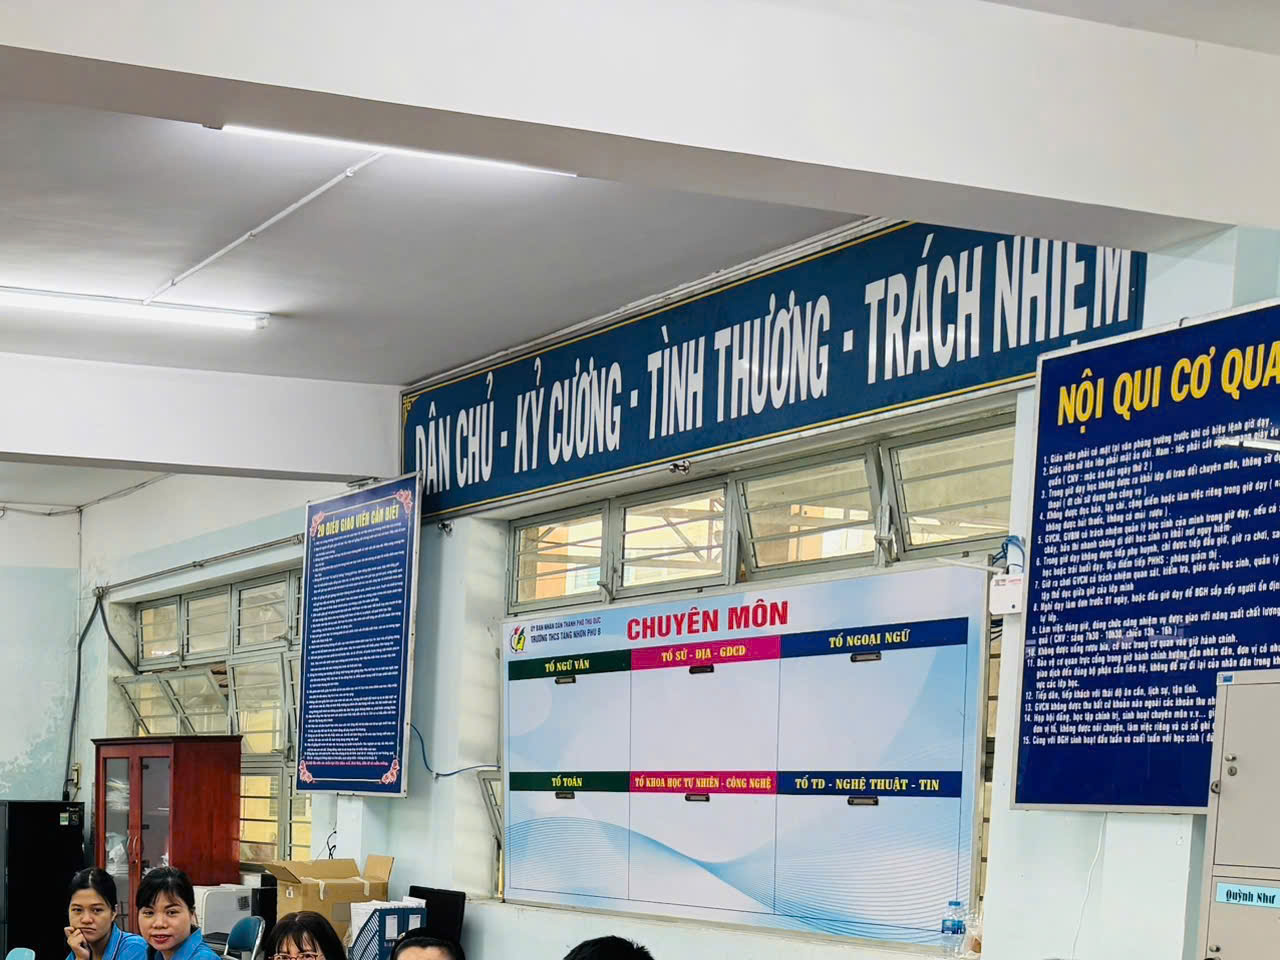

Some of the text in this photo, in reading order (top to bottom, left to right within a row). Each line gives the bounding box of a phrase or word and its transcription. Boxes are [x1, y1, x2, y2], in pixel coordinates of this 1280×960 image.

[416, 401, 450, 495] DÂN
[455, 371, 494, 488] CHỦ
[514, 357, 545, 473] KỶ
[548, 356, 622, 465] CƯƠNG
[647, 325, 705, 440] TÌNH
[714, 290, 830, 423] THƯƠNG
[865, 233, 983, 384] TRÁCH
[1057, 368, 1104, 434] NỘI
[1113, 365, 1162, 420] QUI
[1171, 346, 1216, 402] CƠ
[627, 598, 788, 641] CHUYÊN MÔN
[846, 633, 881, 647] NGOẠI
[885, 628, 910, 644] NGỮ
[563, 774, 582, 787] TOÁN
[646, 777, 665, 788] KHOA
[666, 777, 682, 790] HỌC
[726, 775, 747, 789] CÔNG
[811, 778, 826, 789] TD
[835, 776, 866, 791] NGHỆ
[869, 777, 908, 792] THUẬT
[919, 779, 939, 791] TIN
[1226, 888, 1276, 904] Quỳnh Như
